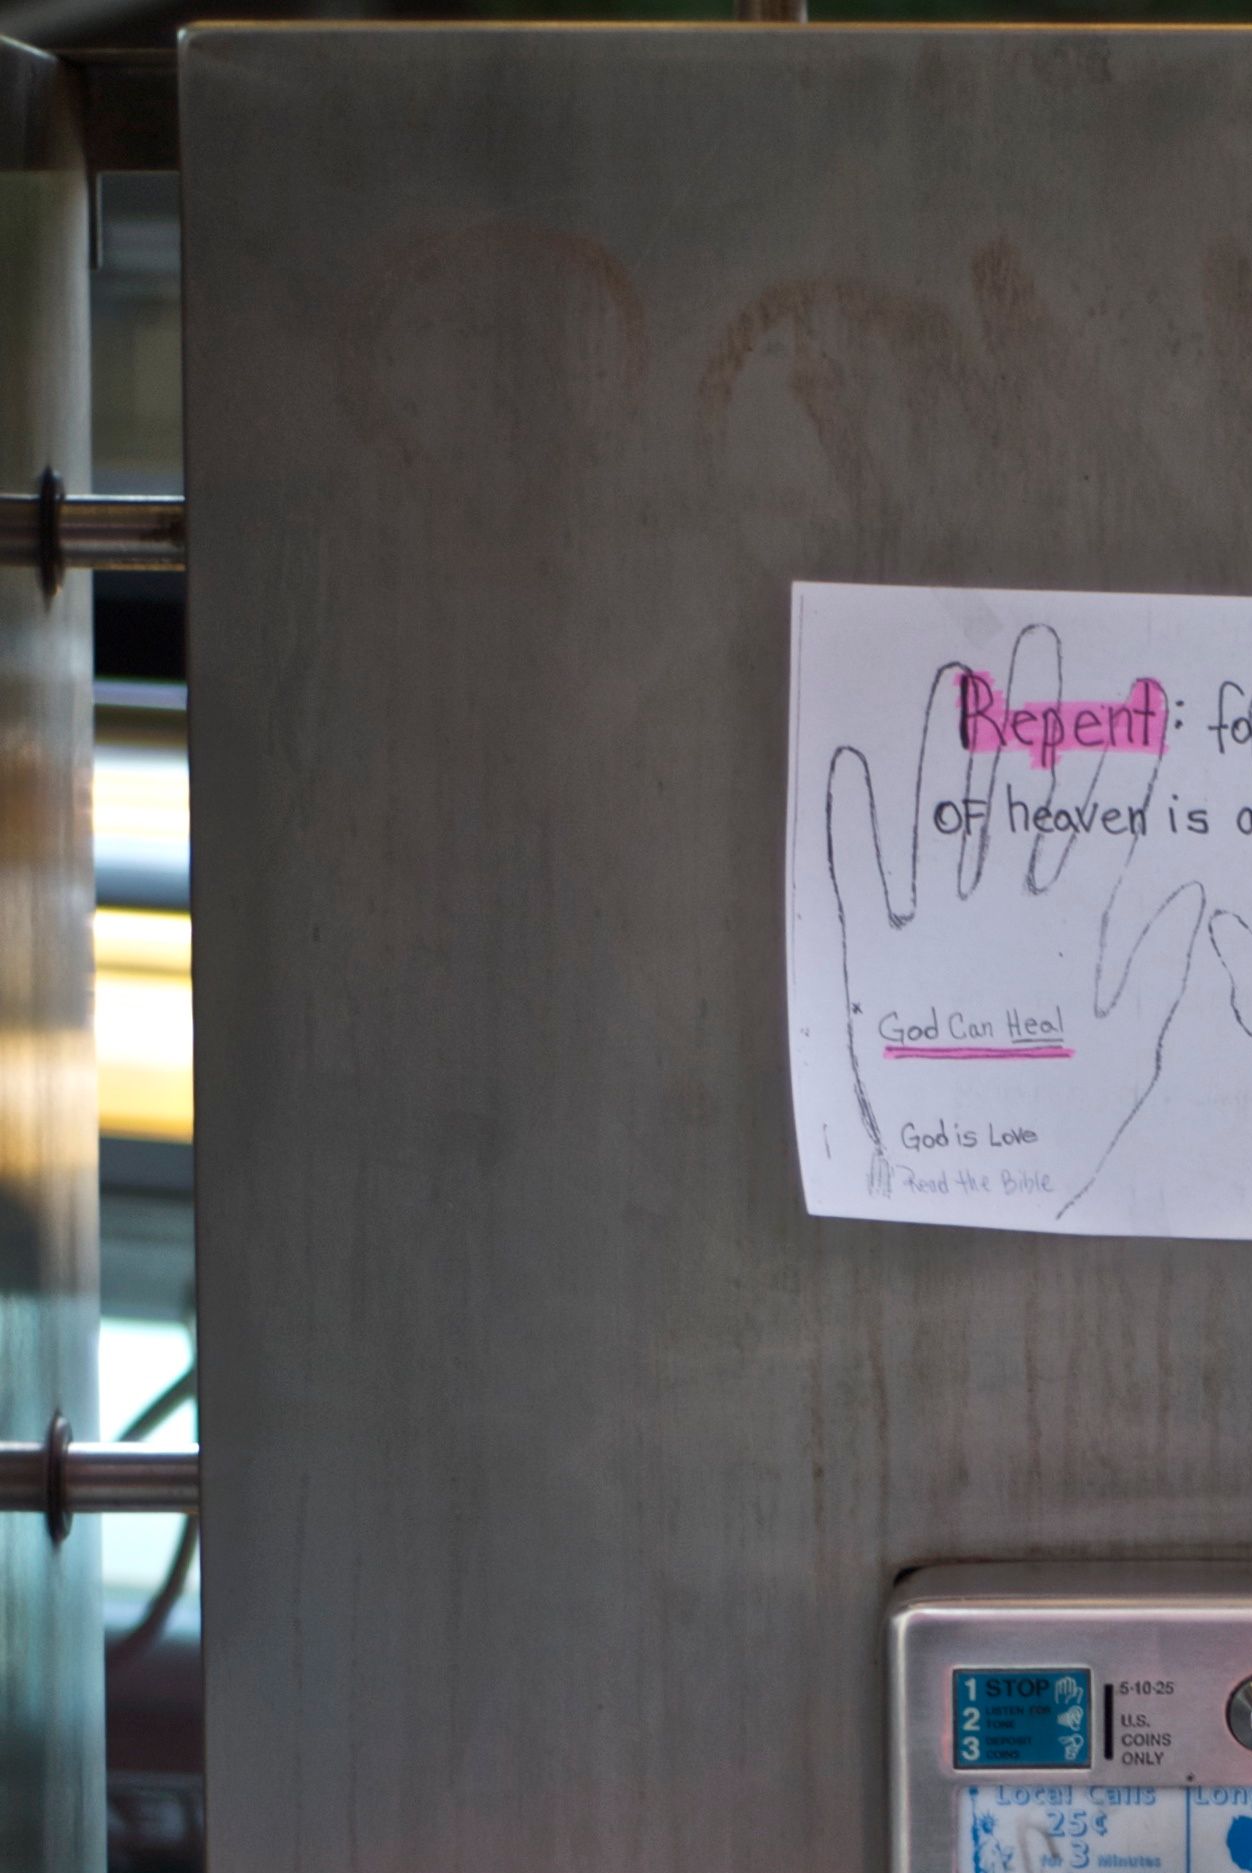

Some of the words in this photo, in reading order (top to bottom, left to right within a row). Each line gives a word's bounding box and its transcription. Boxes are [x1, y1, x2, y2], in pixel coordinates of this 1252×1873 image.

[960, 673, 1184, 768] Repent:
[1006, 783, 1149, 836] heaven
[1168, 794, 1209, 834] is
[877, 1006, 940, 1045] God
[948, 1011, 994, 1040] Can
[1006, 1005, 1064, 1038] Heal
[900, 1118, 950, 1153] God
[953, 1122, 979, 1148] is
[988, 1120, 1040, 1148] Love
[896, 1163, 951, 1194] Read
[953, 1168, 990, 1192] the
[1000, 1168, 1054, 1195] Bible
[965, 1678, 977, 1701] 1
[985, 1678, 1050, 1698] STOP
[962, 1706, 981, 1731] 2
[1120, 1714, 1151, 1728] U.S.
[961, 1736, 981, 1761] 3
[1121, 1733, 1172, 1747] COINS
[1121, 1752, 1165, 1766] ONLY
[996, 1785, 1073, 1806] Local
[1088, 1785, 1157, 1806] Calls
[1070, 1839, 1090, 1869] 3
